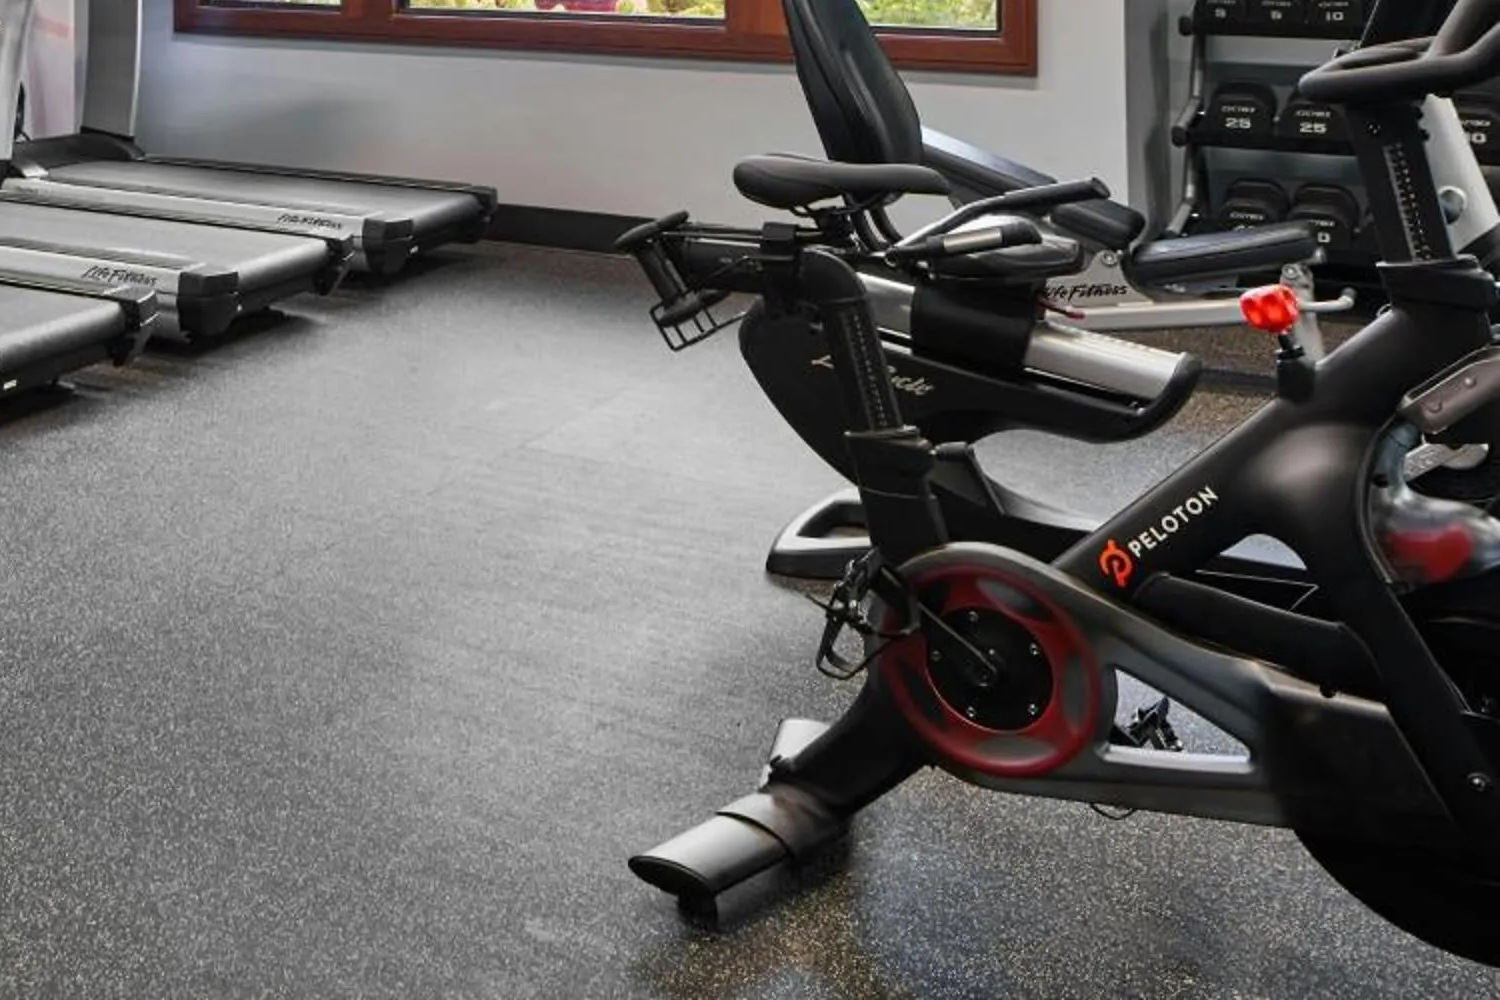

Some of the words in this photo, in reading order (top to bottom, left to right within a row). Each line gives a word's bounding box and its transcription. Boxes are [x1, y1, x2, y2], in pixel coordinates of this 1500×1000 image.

[1325, 11, 1344, 21] 10
[1225, 117, 1251, 129] 25
[1299, 121, 1327, 134] 25
[1127, 485, 1219, 558] PELOTON
